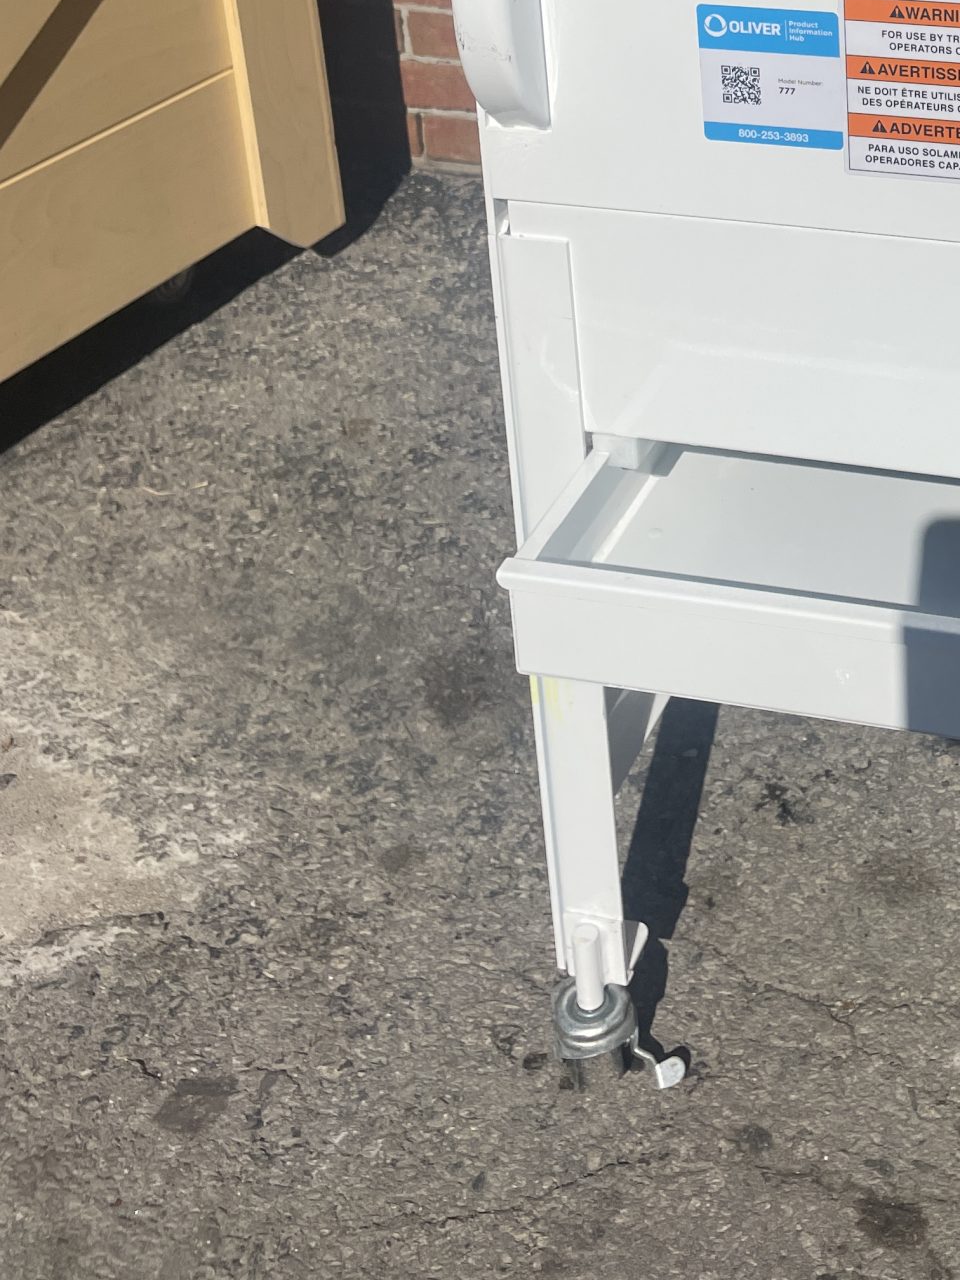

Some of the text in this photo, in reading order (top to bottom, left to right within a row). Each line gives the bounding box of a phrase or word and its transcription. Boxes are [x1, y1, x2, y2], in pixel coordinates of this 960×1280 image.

[729, 20, 781, 36] OLIVER
[788, 20, 818, 29] Product
[788, 28, 833, 37] Information
[789, 34, 804, 42] Hub
[881, 30, 902, 40] FOR
[905, 31, 925, 41] USE
[929, 33, 942, 42] BY
[889, 42, 952, 55] OPERATORS
[778, 86, 796, 96] 777
[857, 86, 870, 95] NE
[874, 87, 897, 97] DOIT
[901, 89, 927, 99] ÊTRE
[861, 97, 882, 107] DES
[885, 99, 954, 113] OPÉRATEURS
[738, 128, 809, 143] 800-253-3893
[868, 144, 895, 154] PARA
[897, 146, 919, 156] USO
[864, 154, 935, 169] OPERADORES
